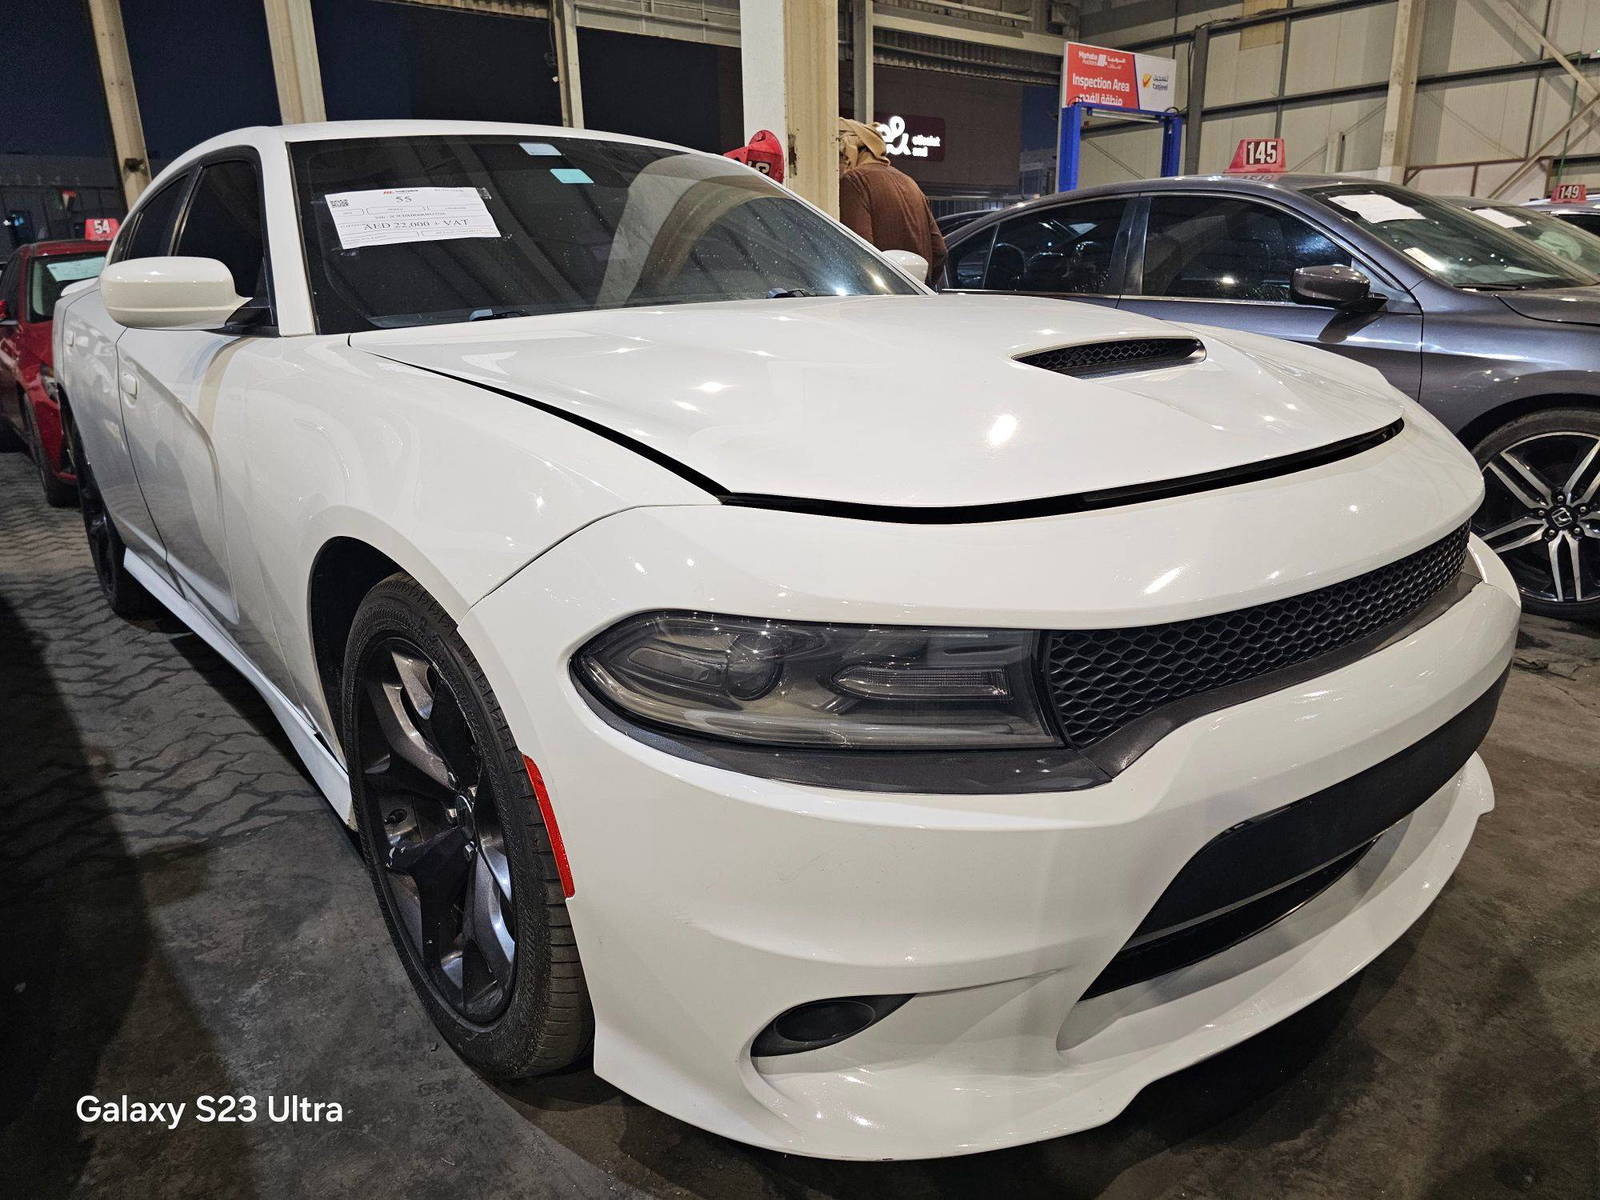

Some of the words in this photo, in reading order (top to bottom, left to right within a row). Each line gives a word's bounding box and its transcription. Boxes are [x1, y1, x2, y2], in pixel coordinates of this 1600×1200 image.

[1072, 73, 1112, 90] Inspection
[1113, 79, 1130, 93] Area
[1248, 141, 1277, 165] 145
[1561, 185, 1579, 199] 149
[396, 195, 412, 204] 55
[94, 219, 111, 234] 54
[364, 221, 391, 231] AED
[444, 218, 470, 227] VAT
